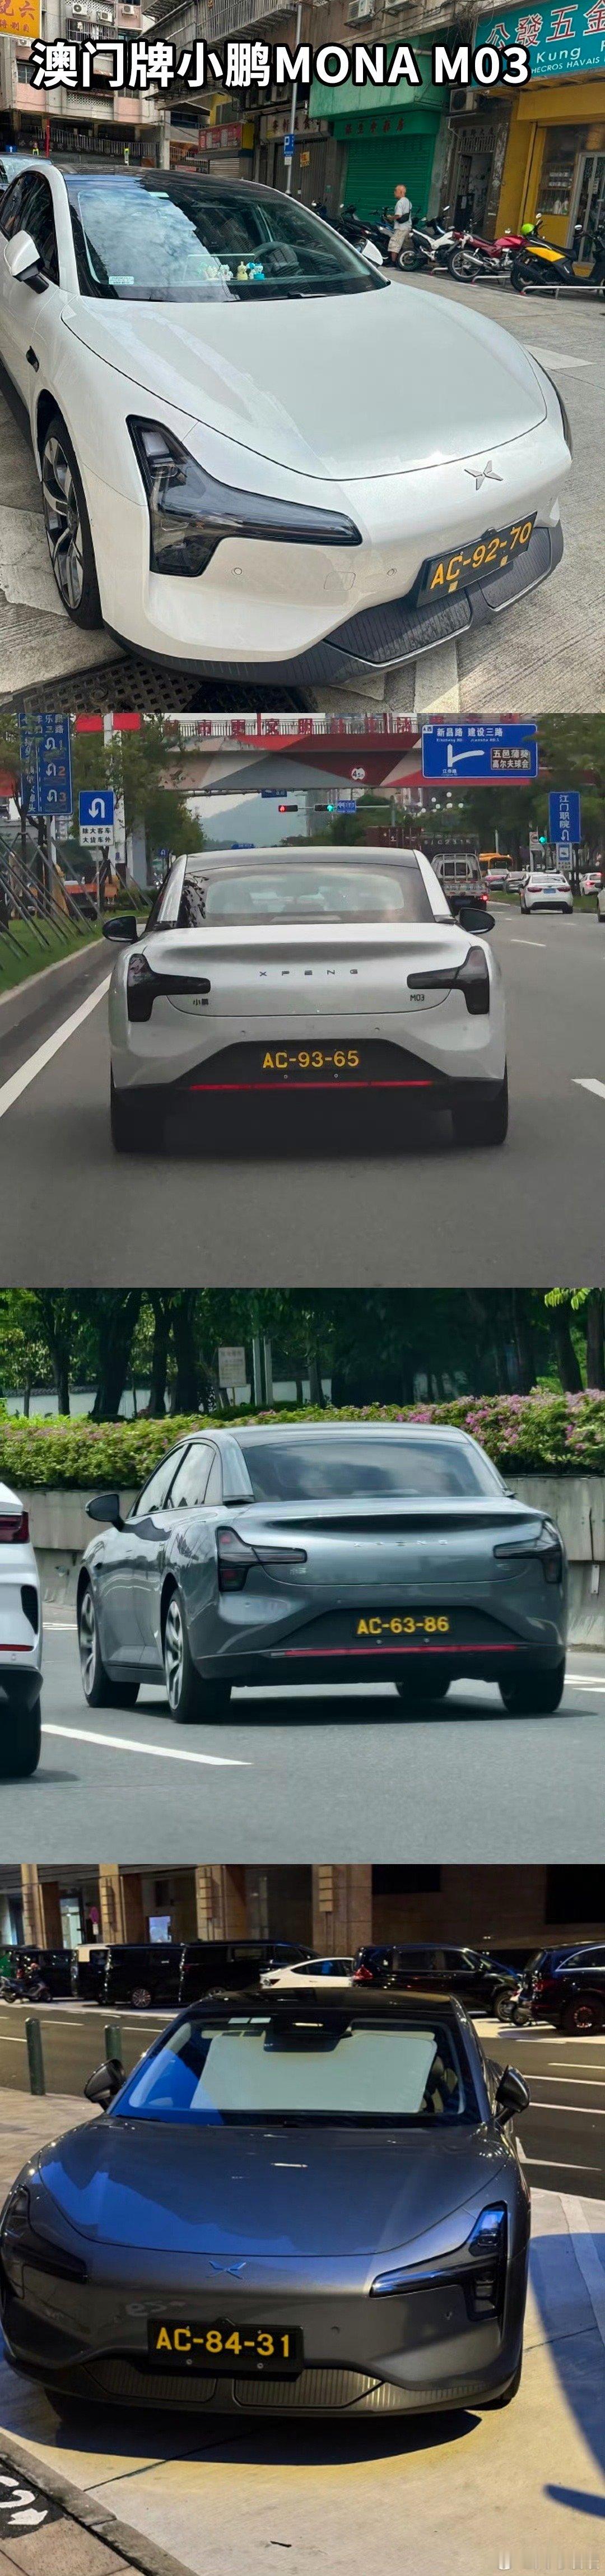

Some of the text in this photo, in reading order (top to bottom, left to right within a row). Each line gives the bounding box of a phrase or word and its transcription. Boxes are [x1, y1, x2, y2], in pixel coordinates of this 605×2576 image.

[536, 47, 581, 64] Kung
[566, 57, 600, 68] HAVAIS
[430, 521, 532, 590] AC-92-70
[437, 728, 503, 737] 新昌路 建设三路
[492, 759, 529, 768] 高尔夫球会
[560, 795, 570, 828] 江门职院
[262, 1050, 359, 1069] AC-93-65
[356, 1616, 450, 1634] AC-63-86
[156, 2327, 289, 2358] AC-84-31
